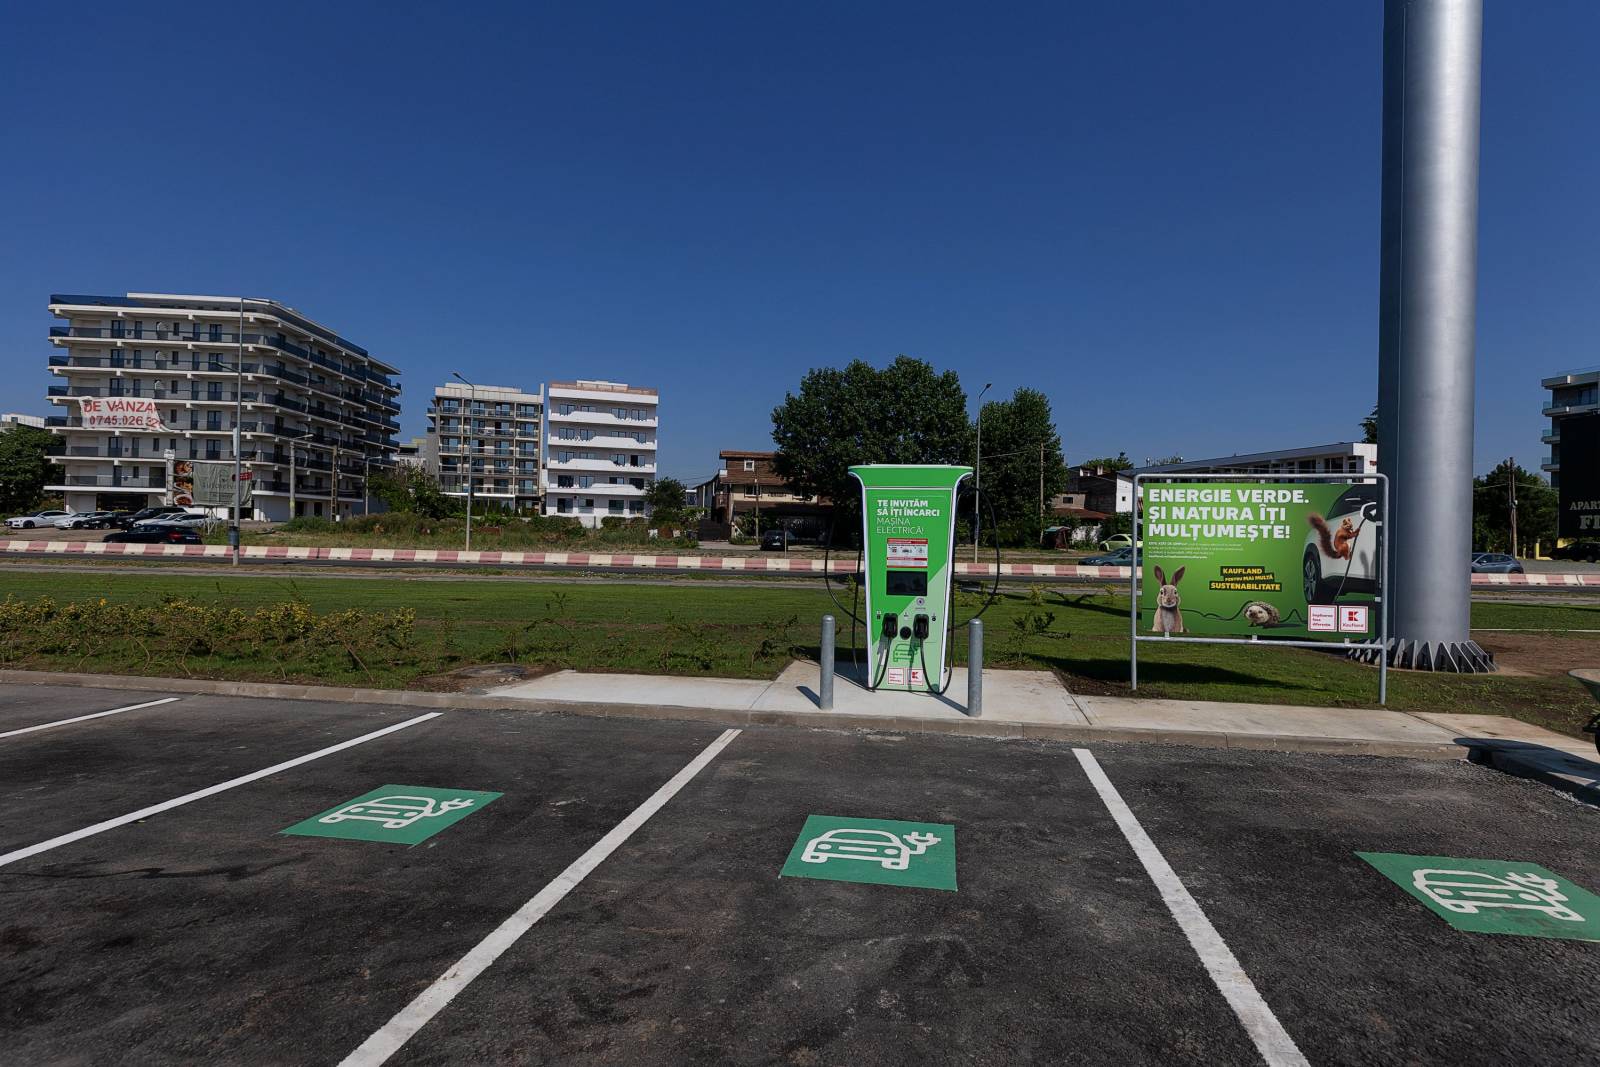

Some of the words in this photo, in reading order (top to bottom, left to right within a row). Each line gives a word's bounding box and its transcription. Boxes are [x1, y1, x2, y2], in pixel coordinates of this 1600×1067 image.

[83, 401, 101, 413] DE
[1148, 488, 1232, 503] ENERGIE
[1236, 489, 1310, 503] VERDE.
[877, 499, 888, 507] TE
[877, 507, 888, 516] SĂ
[903, 507, 940, 516] ÎNCARCI
[1148, 506, 1167, 523] ȘI
[1171, 506, 1254, 521] NATURA
[1259, 503, 1286, 524] ÎȚI
[876, 517, 911, 526] MAȘINA
[876, 526, 924, 534] ELECTRICĂ!
[1148, 524, 1291, 542] MULȚUMEȘTE!
[1210, 582, 1281, 590] SUSTENABILITATE
